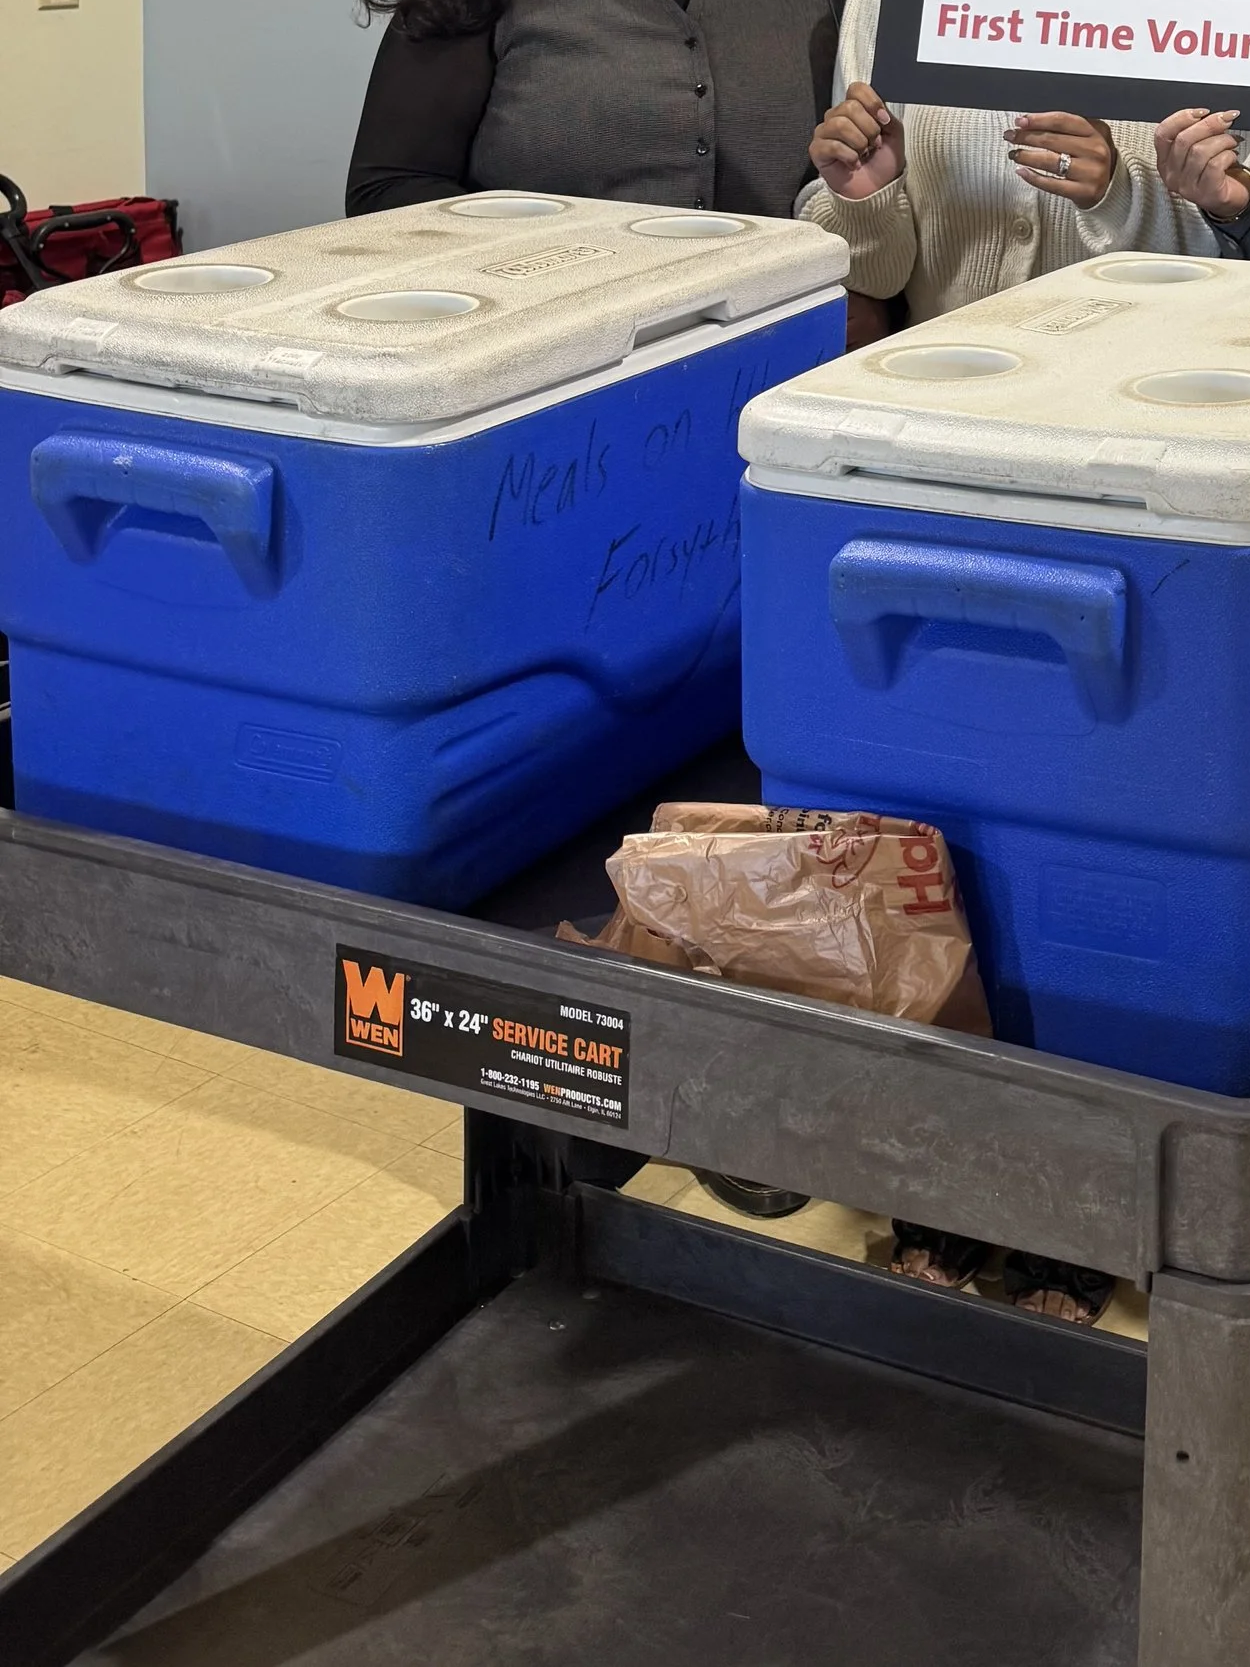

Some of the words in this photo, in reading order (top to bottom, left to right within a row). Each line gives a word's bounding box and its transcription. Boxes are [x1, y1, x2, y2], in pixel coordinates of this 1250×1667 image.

[937, 3, 1024, 42] First
[1035, 11, 1134, 50] Time
[644, 409, 691, 468] on
[350, 1018, 398, 1048] WEN
[410, 998, 440, 1022] 36"
[459, 1010, 488, 1034] 24"
[493, 1018, 568, 1056] SERVICE
[574, 1037, 622, 1069] CART
[560, 1005, 593, 1023] MODEL
[596, 1013, 624, 1030] 73004
[480, 1068, 540, 1091] 1-800-232-1195
[543, 1083, 622, 1111] WENPRODUCTS.COM
[511, 1050, 543, 1067] CHARIOT
[545, 1059, 585, 1077] UTILITAIRE
[587, 1069, 622, 1086] ROBUSTE
